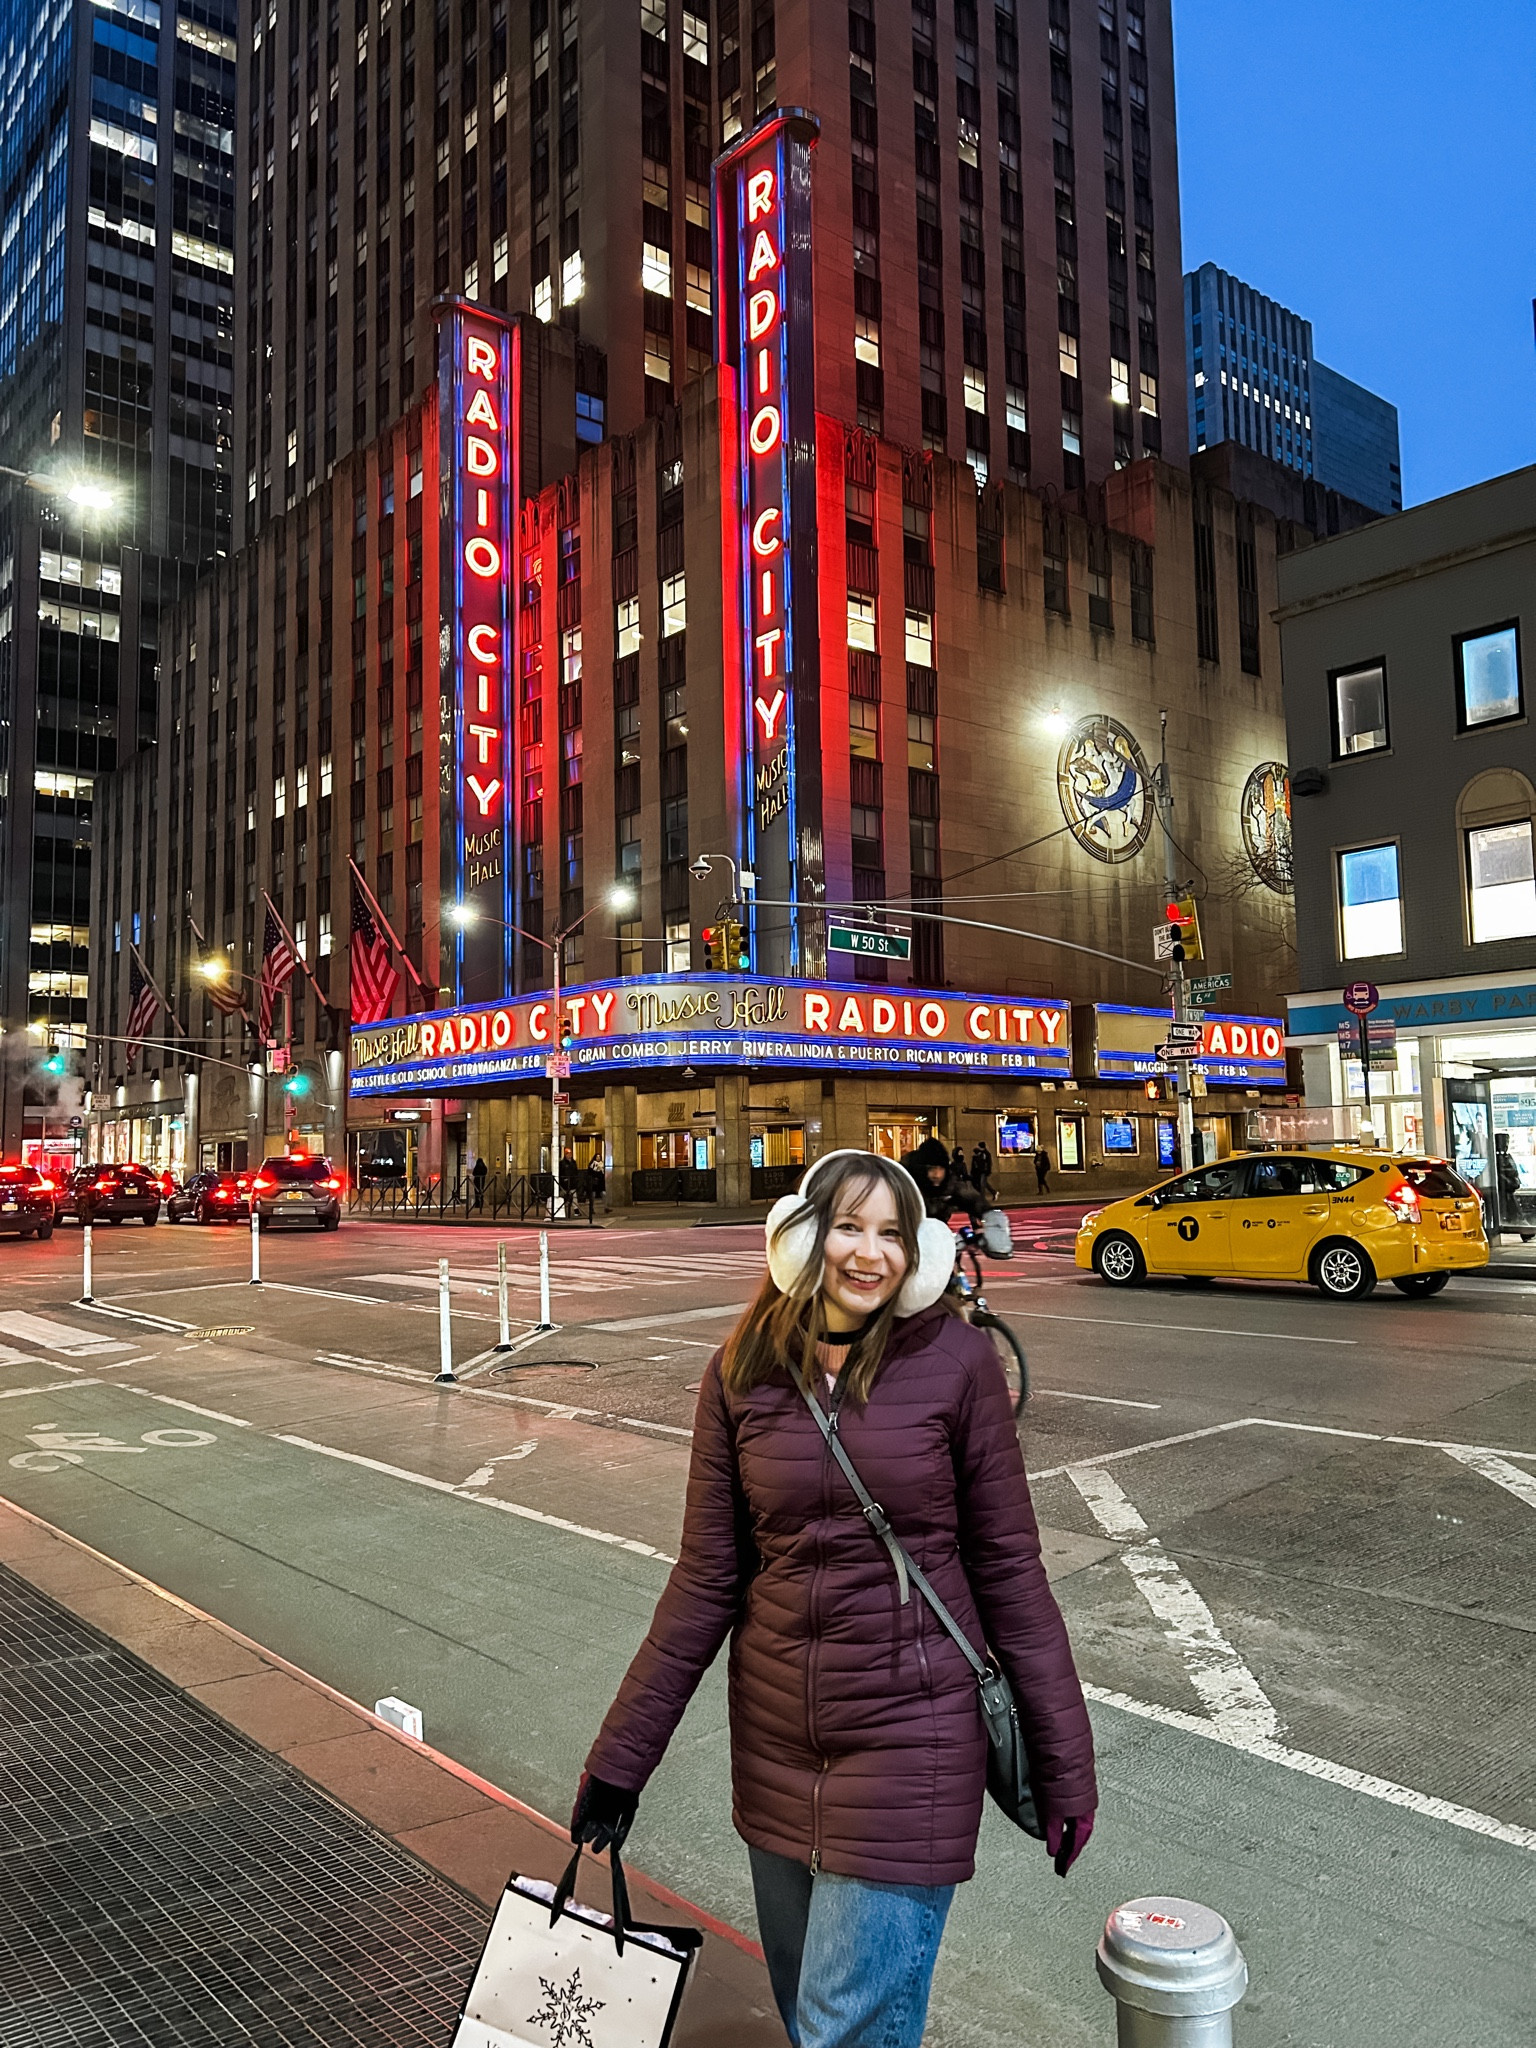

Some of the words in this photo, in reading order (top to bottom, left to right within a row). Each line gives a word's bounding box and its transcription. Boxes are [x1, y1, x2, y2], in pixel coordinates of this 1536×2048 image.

[747, 169, 781, 454] RADIO
[465, 336, 500, 578] RADIO
[753, 507, 785, 739] CITY
[466, 624, 501, 816] CITY
[851, 934, 859, 948] W
[862, 936, 875, 950] 50
[878, 938, 889, 952] St
[1193, 979, 1230, 990] AMERICAS
[626, 990, 721, 1029] Music
[715, 987, 789, 1029] Hall
[1196, 993, 1203, 1003] 6
[1393, 998, 1478, 1019] WARBY
[421, 1011, 511, 1055] RADIO
[529, 991, 616, 1041] CTY
[804, 993, 946, 1038] RADIO
[969, 1005, 1061, 1043] CITY
[1193, 1011, 1200, 1021] 50
[1338, 1021, 1350, 1029] M5
[353, 1036, 389, 1067] Music
[386, 1022, 419, 1065] Hall
[578, 1045, 607, 1063] GRAN
[678, 1041, 732, 1057] JERRY
[799, 1044, 834, 1060] INDIA
[837, 1046, 846, 1060] &
[849, 1046, 900, 1062] PUERTO
[906, 1049, 943, 1065] RICAN
[948, 1051, 989, 1067] POWER
[1001, 1053, 1023, 1068] FEB
[1027, 1054, 1036, 1069] 11
[1180, 1047, 1195, 1055] WAY
[1340, 1041, 1351, 1049] M7
[398, 1070, 413, 1082] OLD
[417, 1066, 447, 1082] SCHOOL
[452, 1057, 518, 1077] EXTRAVAGANZA
[522, 1054, 541, 1068] FEB
[1219, 1065, 1236, 1077] FEB
[1239, 1066, 1248, 1077] 15
[1182, 1221, 1194, 1238] T
